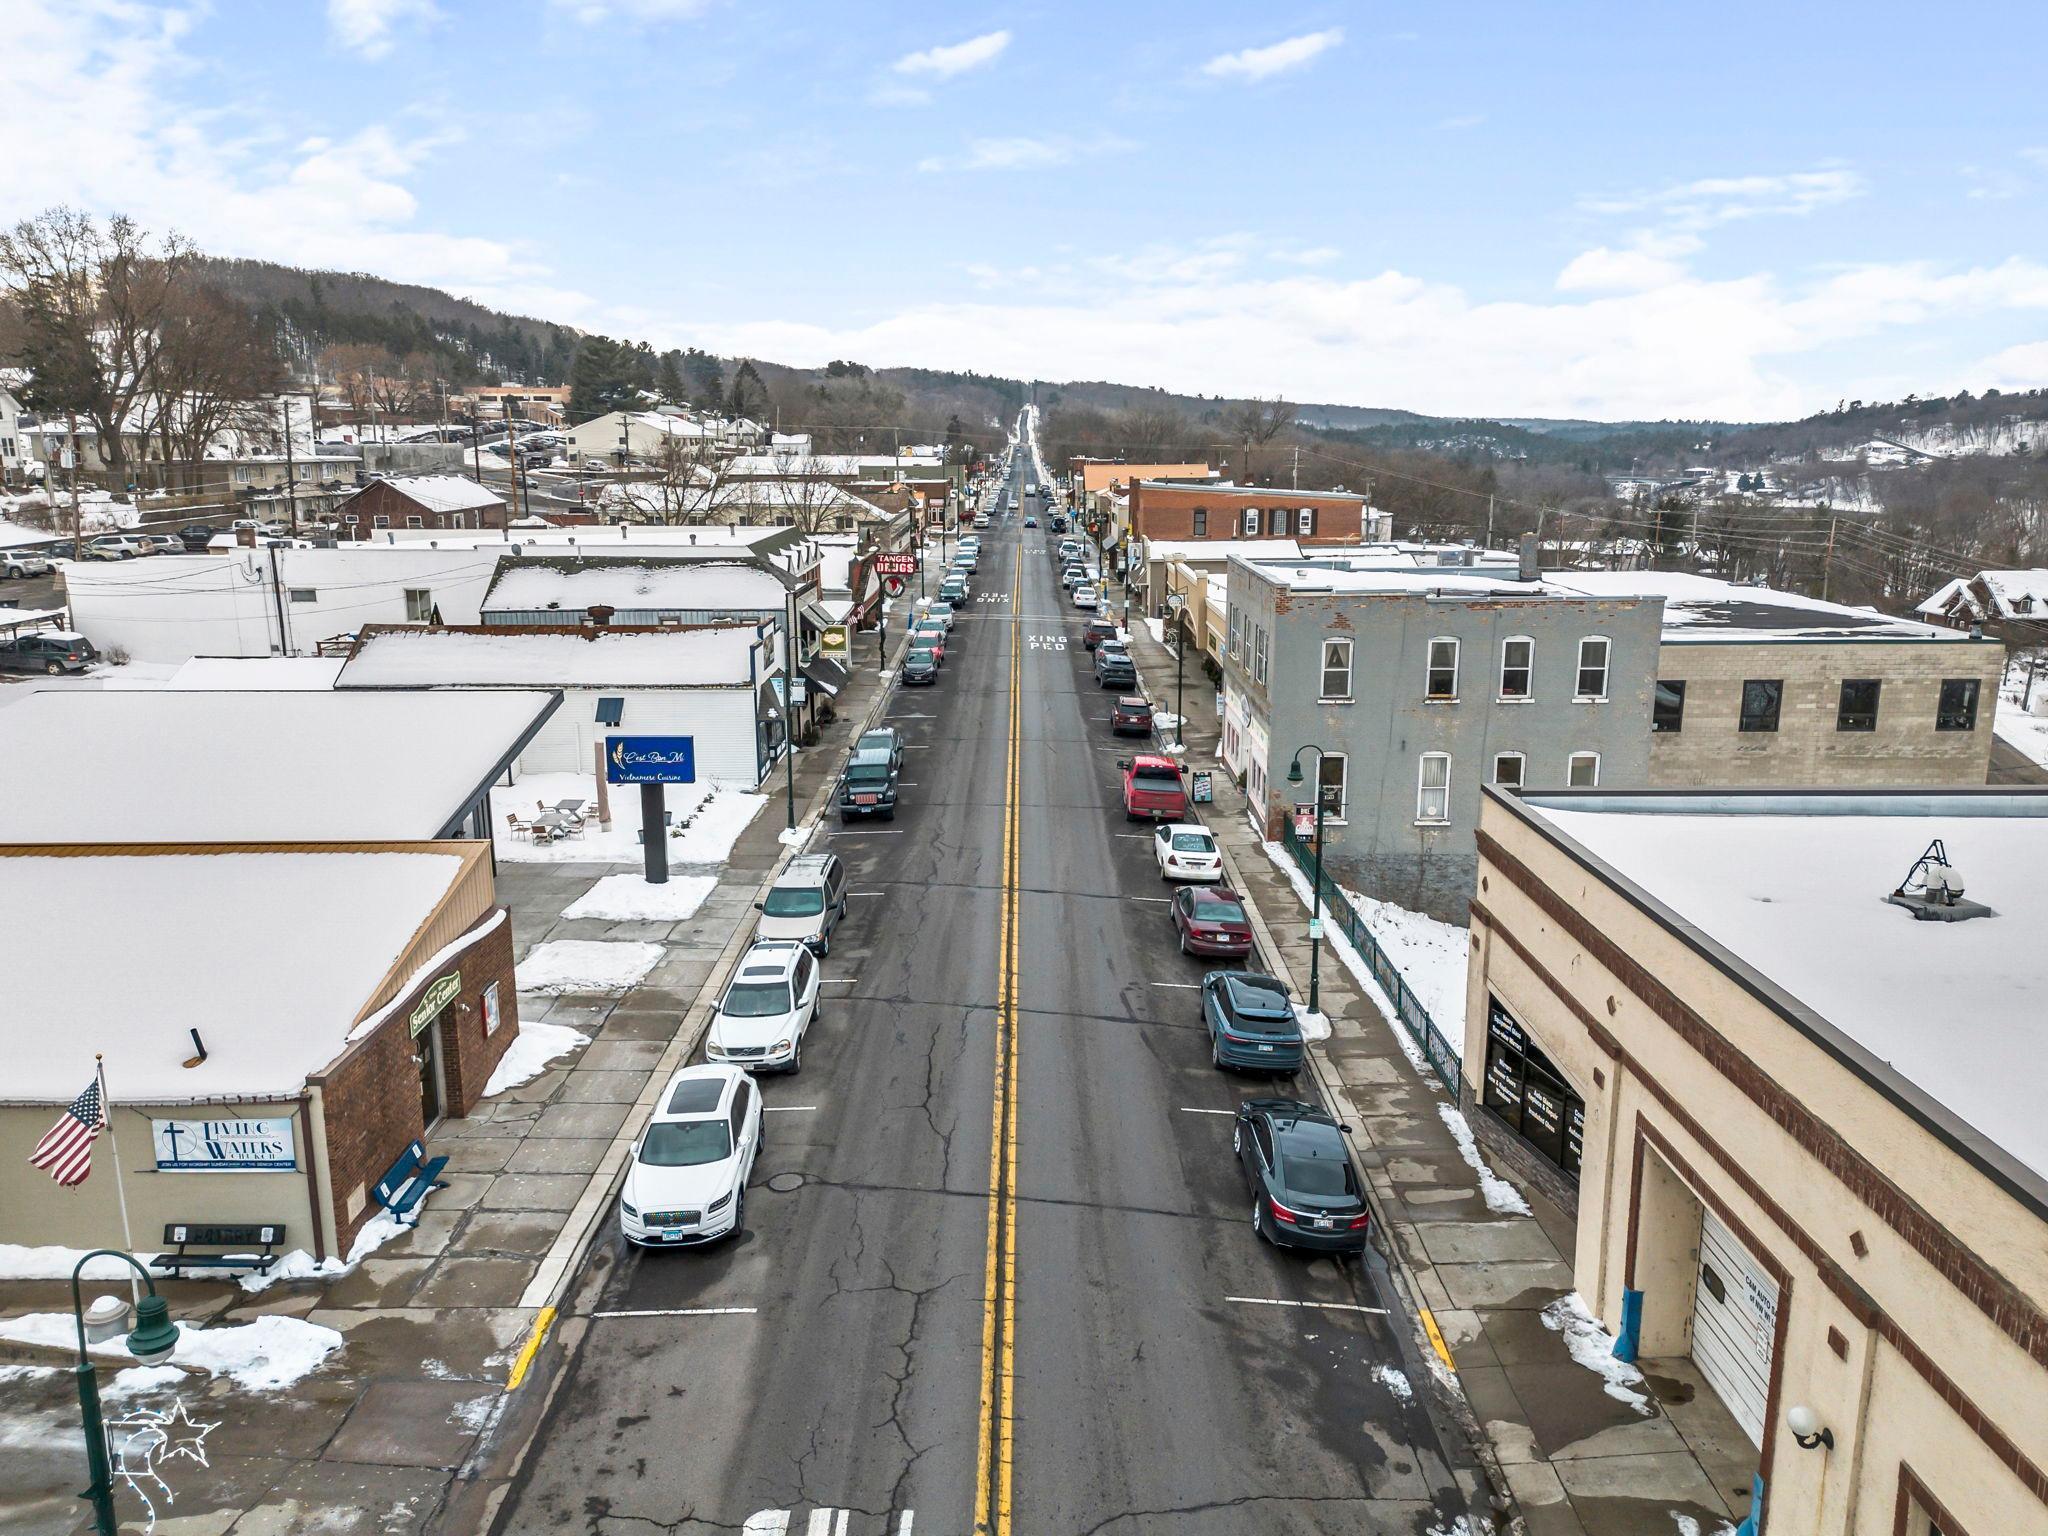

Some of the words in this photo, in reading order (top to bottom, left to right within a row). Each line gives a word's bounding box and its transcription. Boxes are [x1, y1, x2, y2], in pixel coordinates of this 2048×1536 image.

[877, 555, 914, 563] TANGEN
[876, 562, 914, 573] DRUGS
[1028, 635, 1068, 643] XING
[1030, 642, 1065, 651] PED
[619, 773, 655, 781] Vietnamese
[657, 772, 681, 781] Cuisine
[412, 1000, 436, 1030] Senior
[436, 978, 459, 1005] Center
[202, 1121, 270, 1141] LIVING
[203, 1141, 284, 1160] WATERS
[1756, 1290, 1771, 1310] AUTO
